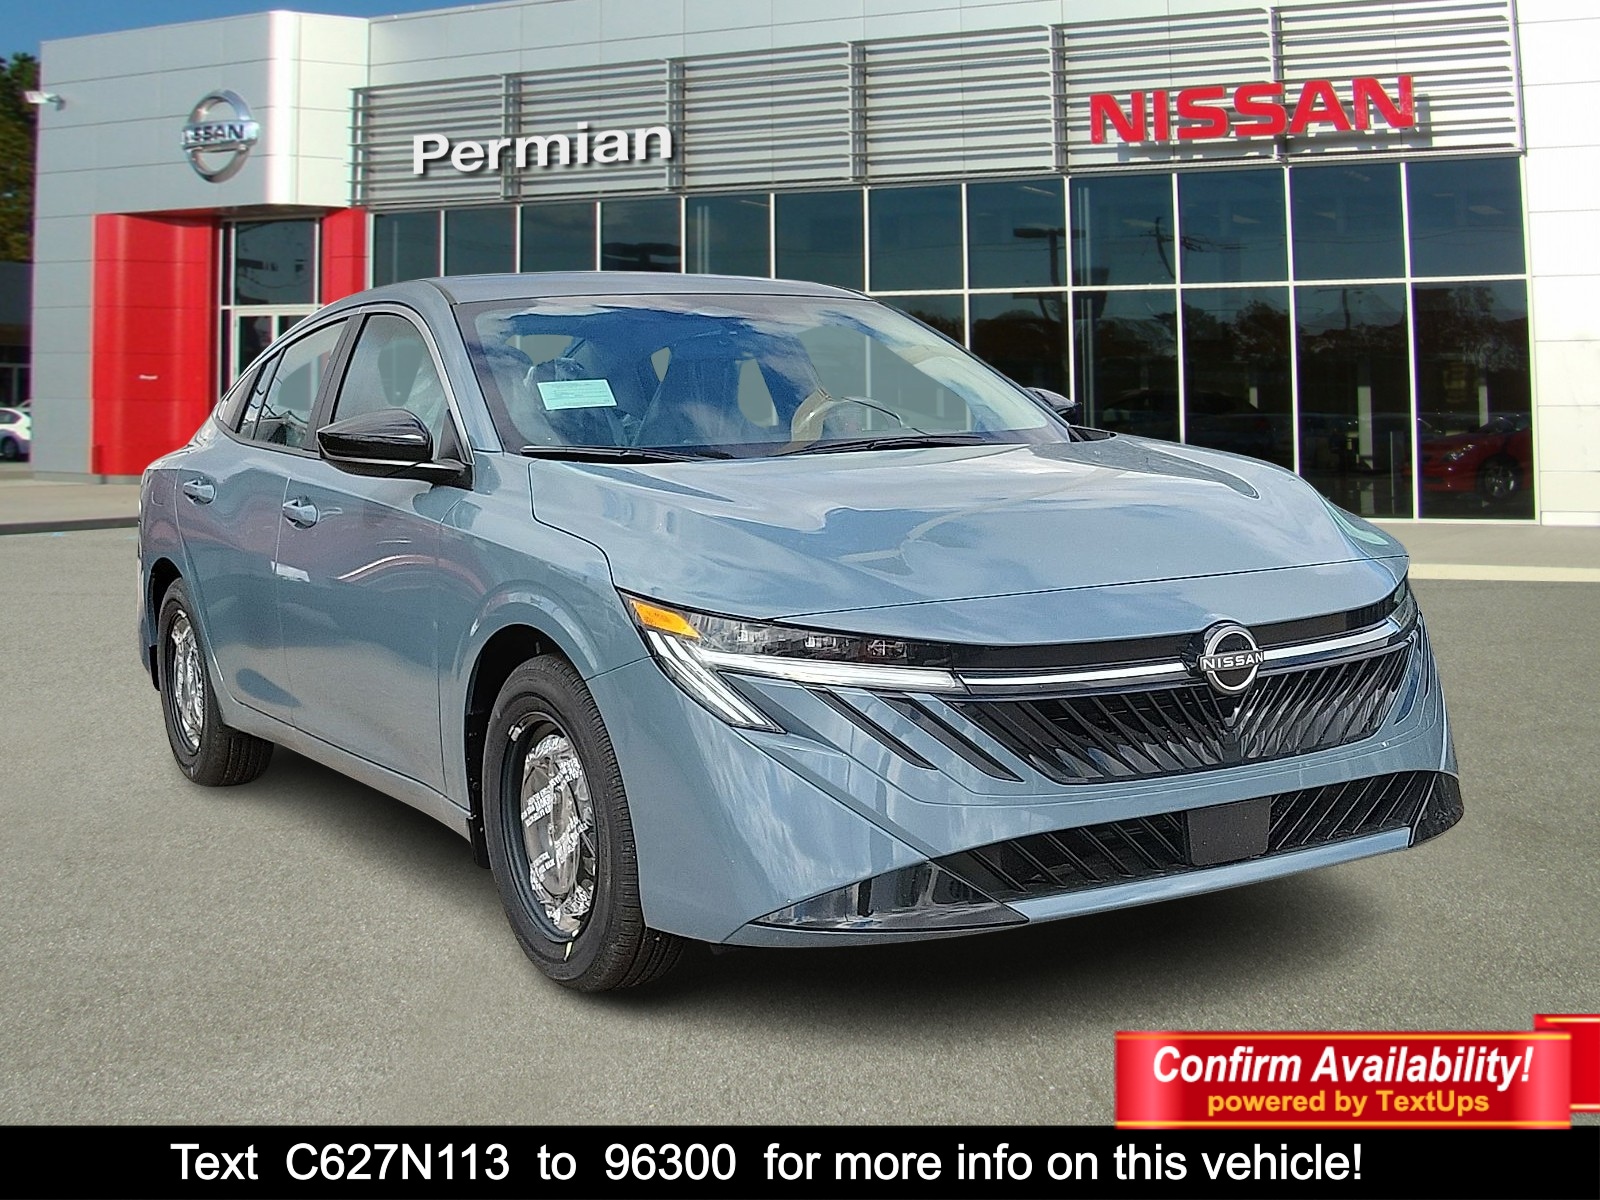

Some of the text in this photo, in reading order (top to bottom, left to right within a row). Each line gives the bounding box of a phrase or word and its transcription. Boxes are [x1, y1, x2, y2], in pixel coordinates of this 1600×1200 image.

[1090, 75, 1415, 144] NISSAN
[413, 121, 673, 175] Permian
[1202, 651, 1264, 670] NISSAN
